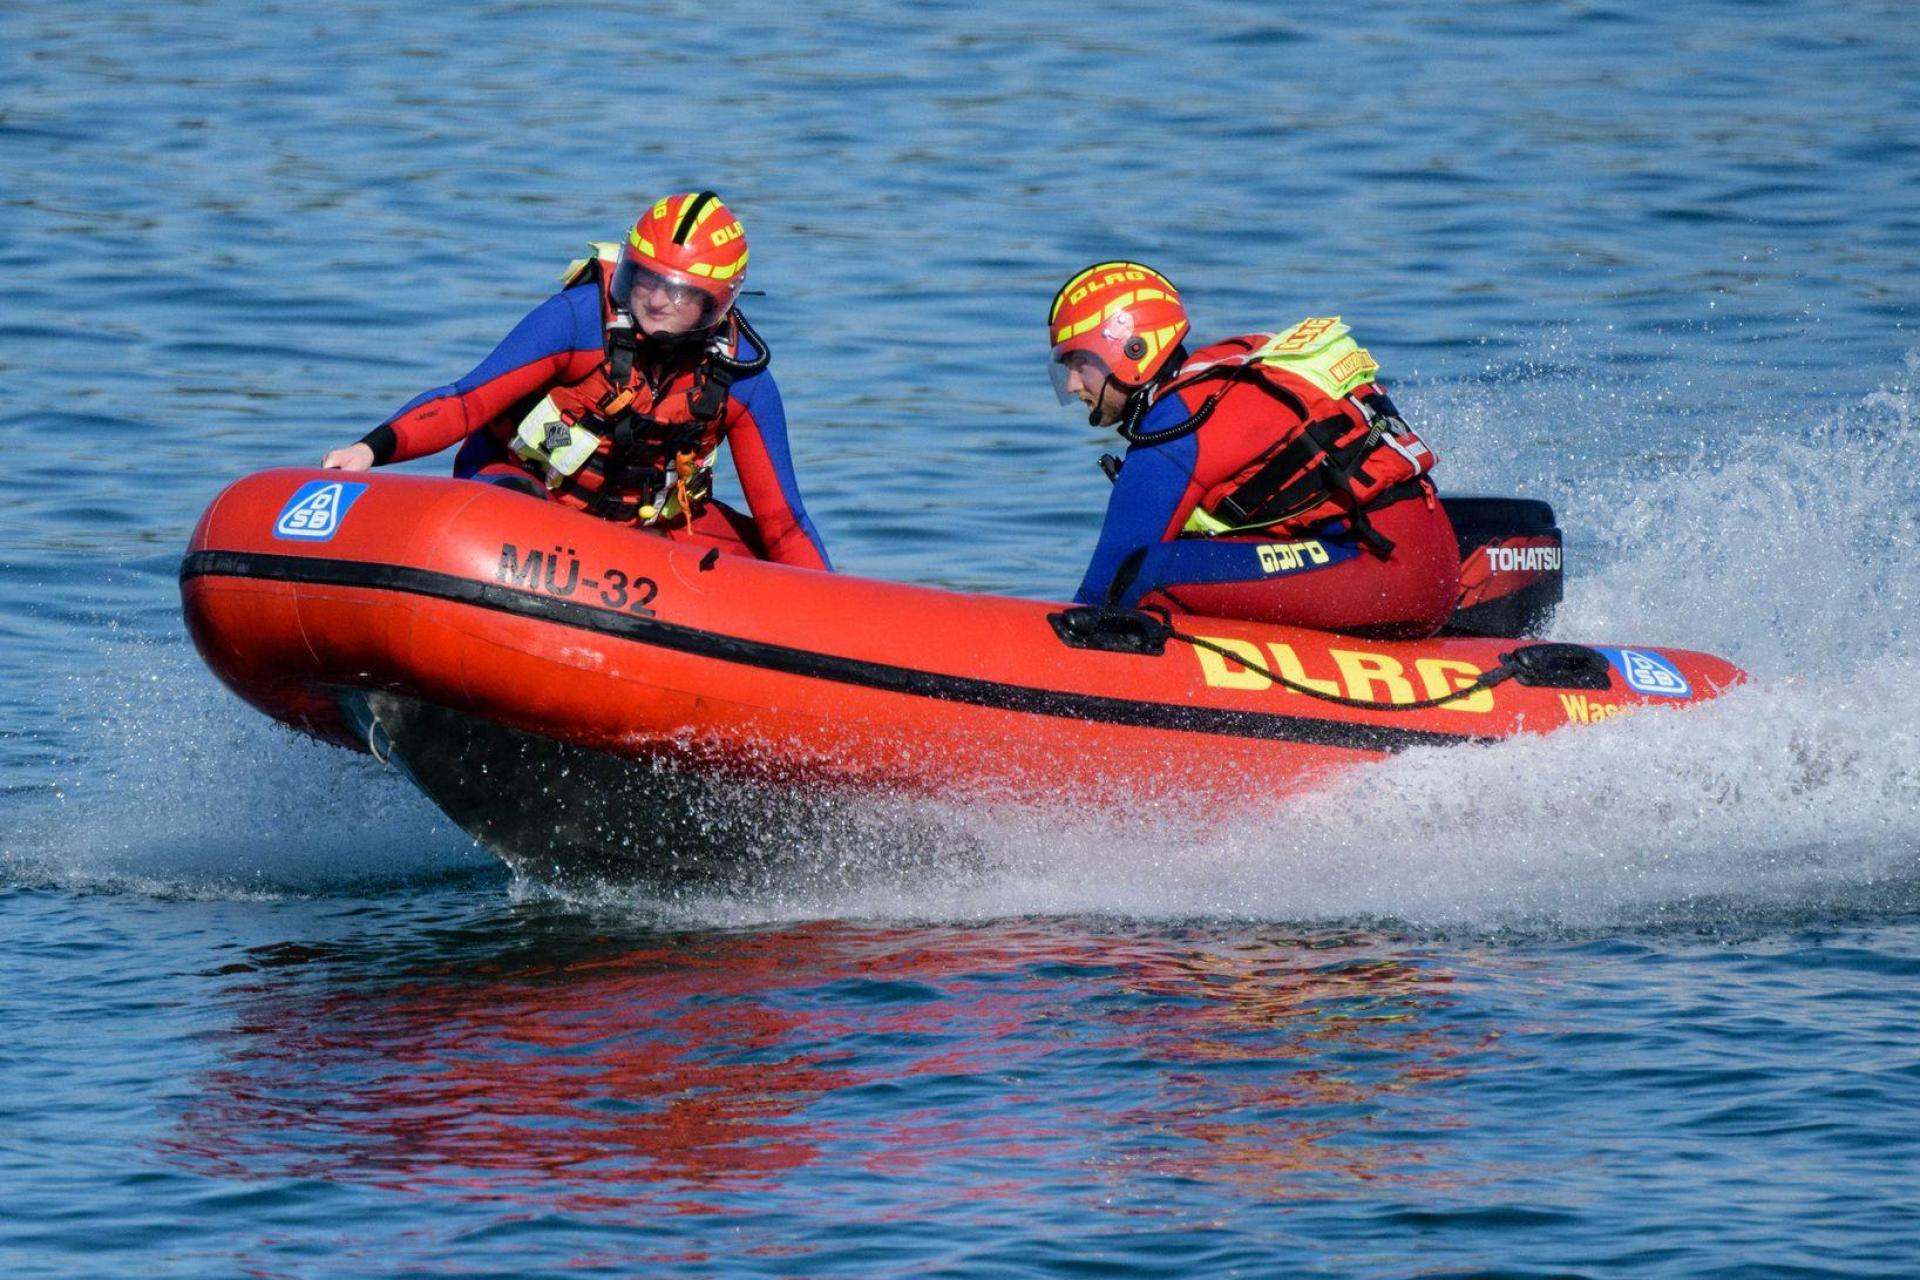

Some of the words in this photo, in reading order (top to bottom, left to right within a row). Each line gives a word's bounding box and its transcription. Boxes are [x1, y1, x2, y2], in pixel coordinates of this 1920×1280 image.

[1070, 271, 1145, 306] DLRG
[497, 543, 658, 617] MÜ-32
[1486, 547, 1561, 571] TOHATSU
[1193, 636, 1495, 713] DLRG
